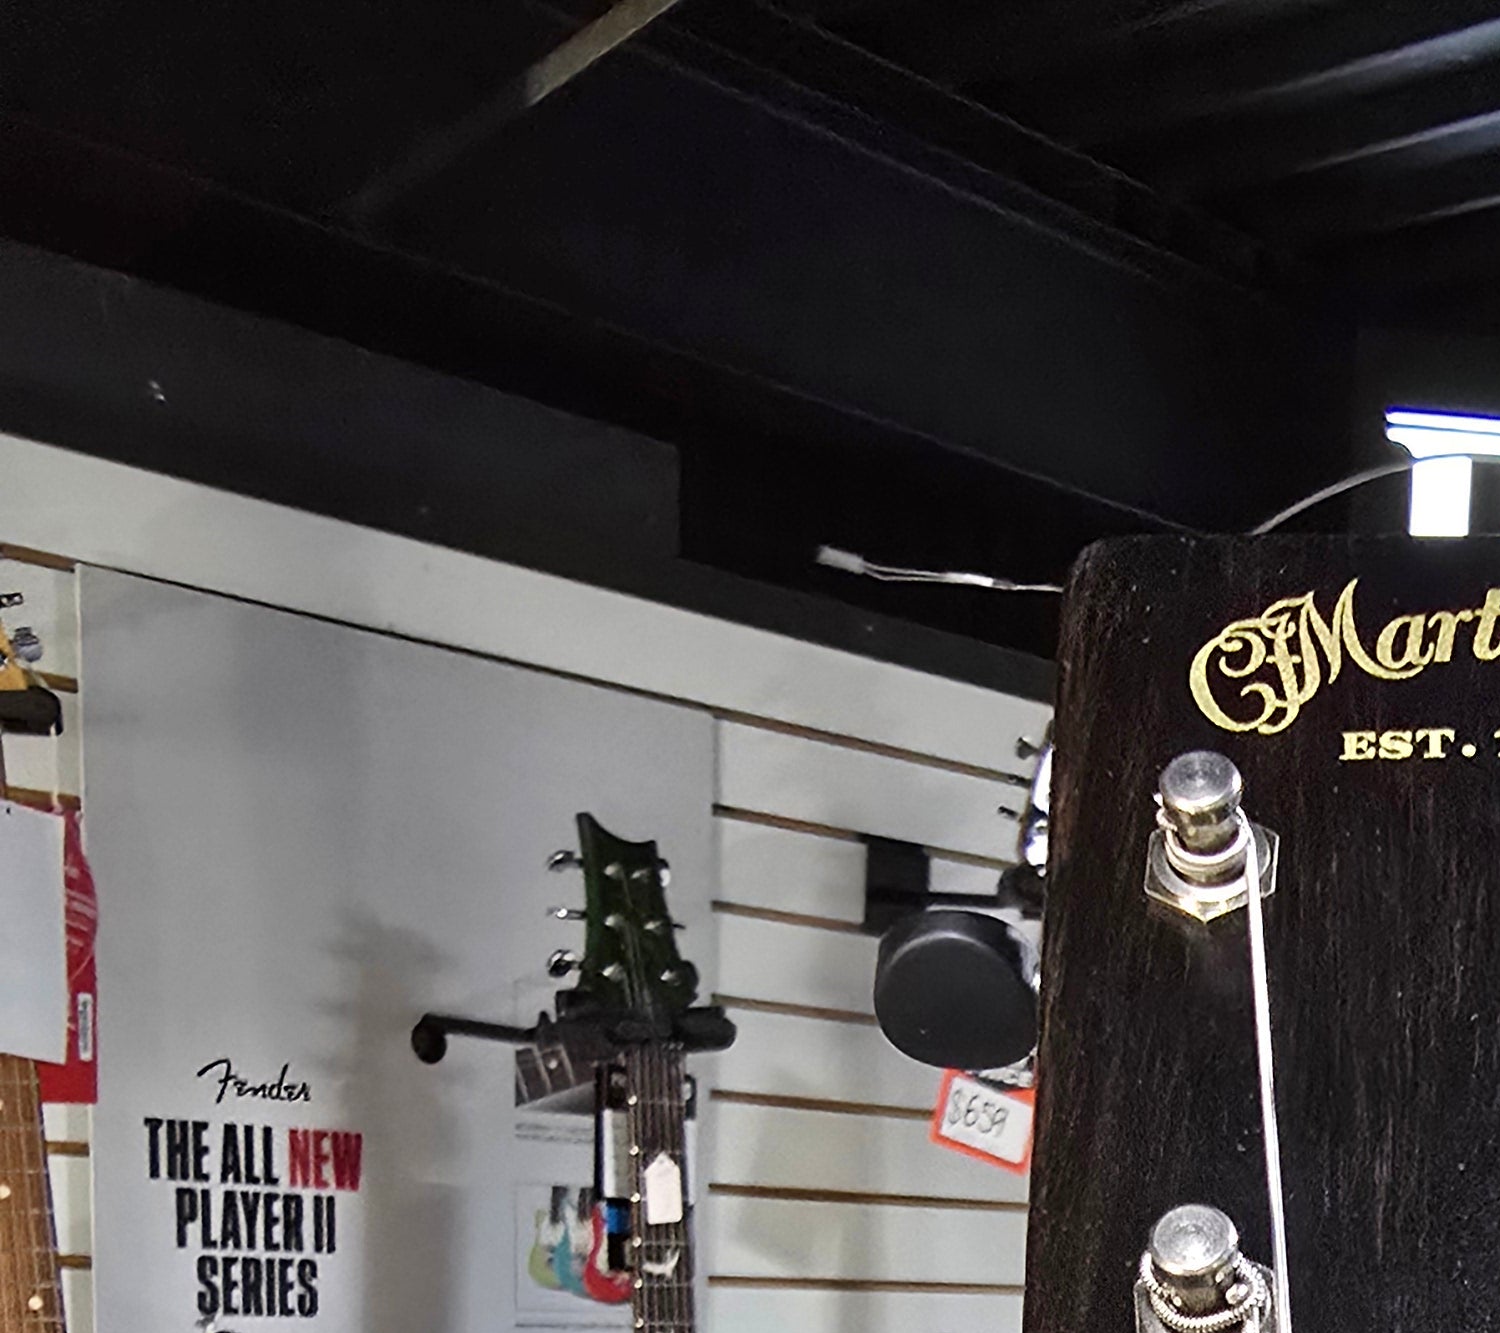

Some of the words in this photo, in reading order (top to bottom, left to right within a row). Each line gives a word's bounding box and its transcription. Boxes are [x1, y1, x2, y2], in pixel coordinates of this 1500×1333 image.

[1338, 727, 1477, 762] EST.
[196, 1058, 312, 1103] Fender
[144, 1117, 210, 1183] THE
[220, 1122, 279, 1187] ALL
[288, 1128, 363, 1192] NEW
[175, 1187, 304, 1253] PLAYER
[313, 1195, 337, 1255] II
[197, 1255, 319, 1318] SERIES
